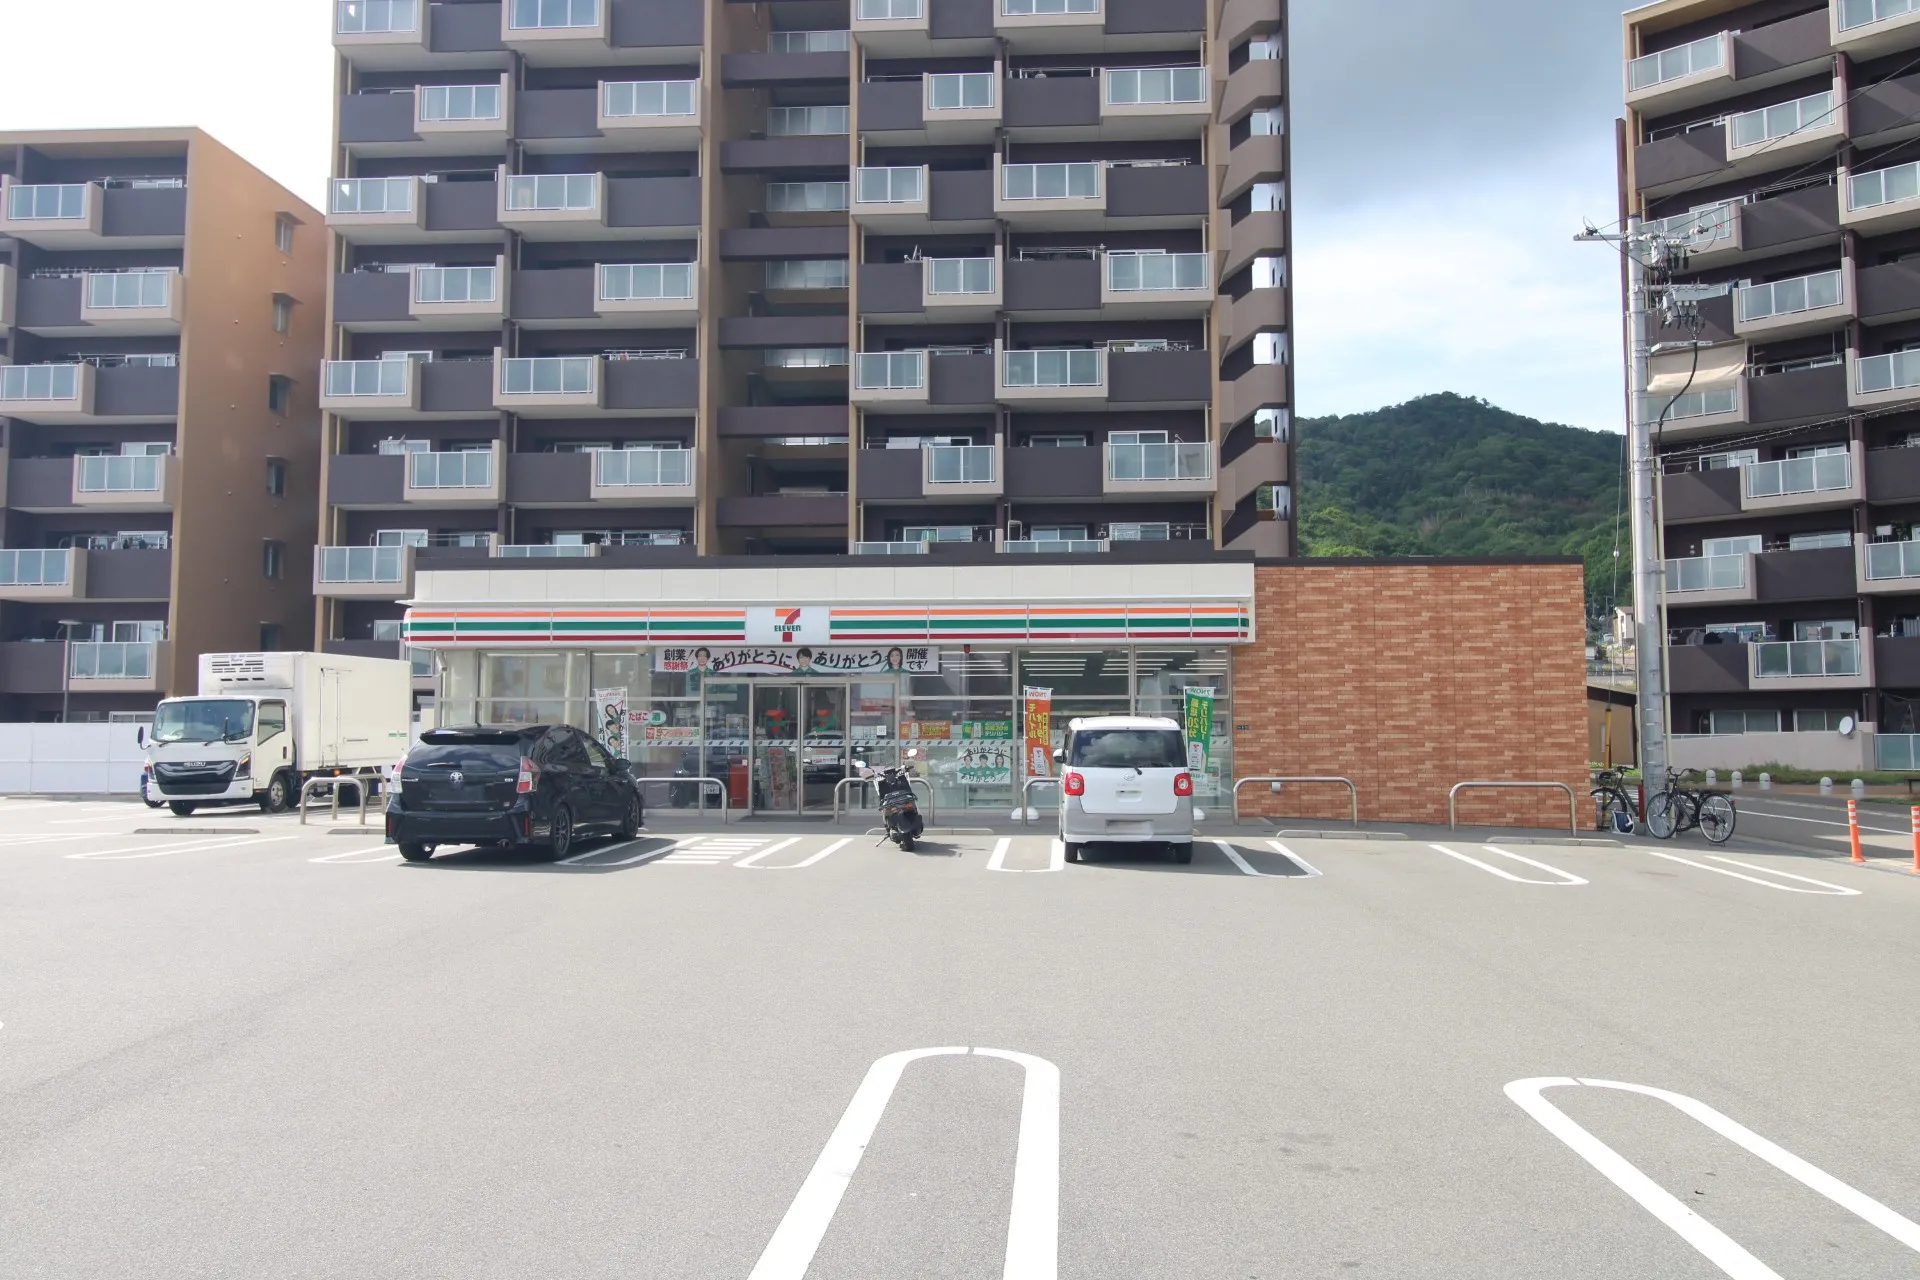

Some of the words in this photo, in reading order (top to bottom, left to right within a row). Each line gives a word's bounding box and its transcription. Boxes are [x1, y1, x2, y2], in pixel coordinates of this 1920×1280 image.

[812, 650, 882, 669] ありがとう
[906, 648, 928, 660] 開催
[628, 712, 648, 721] たばこ
